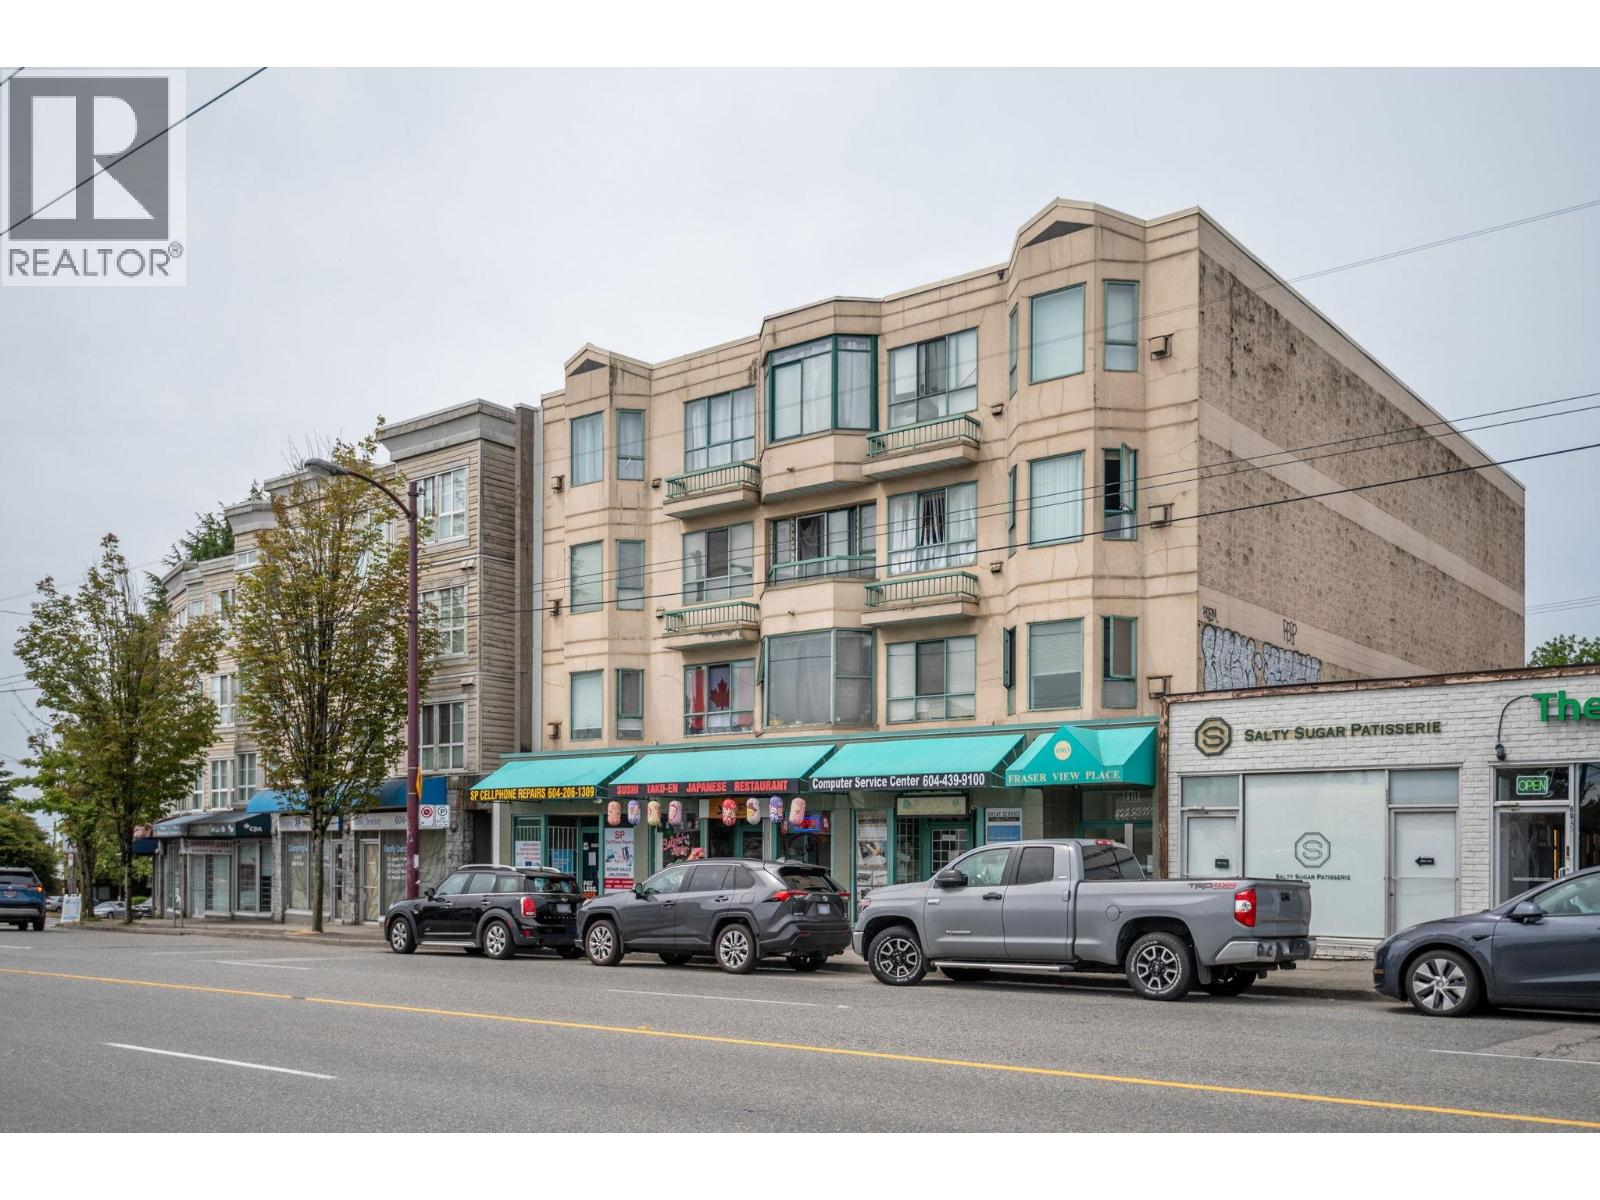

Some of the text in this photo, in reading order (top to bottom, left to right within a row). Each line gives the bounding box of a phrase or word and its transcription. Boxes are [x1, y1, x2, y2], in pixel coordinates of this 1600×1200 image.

[1530, 690, 1600, 722] The
[1244, 721, 1442, 742] SALTY SUGAR PATISSERIE
[812, 773, 985, 791] Computer Service Center 604-439-9100
[1007, 770, 1120, 783] FRASER VIEW PLACE
[470, 789, 479, 800] SP
[479, 787, 517, 800] CELLPHONE
[518, 786, 546, 799] REPAIRS
[616, 780, 789, 795] SUSHI TAKU-EN JAPANESE RESTAURANT
[1518, 780, 1547, 791] OPEN
[614, 830, 625, 839] SP
[1302, 840, 1323, 860] S
